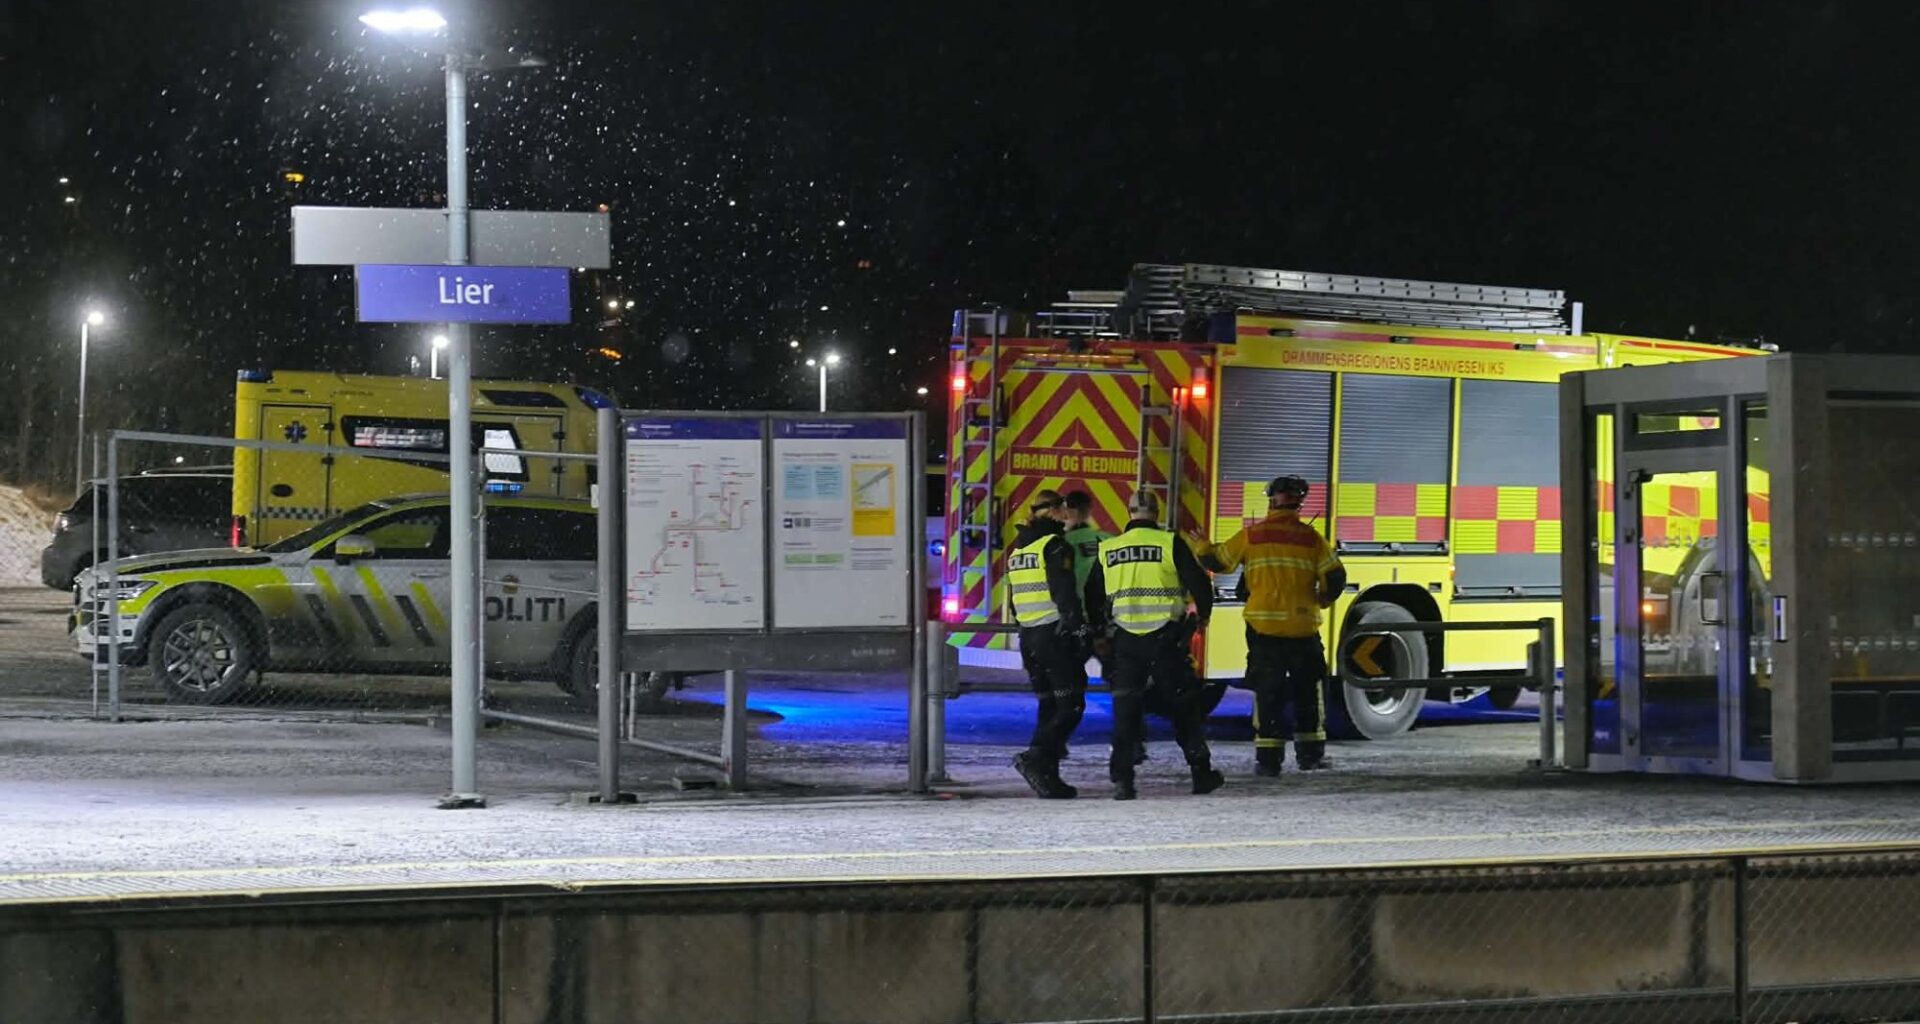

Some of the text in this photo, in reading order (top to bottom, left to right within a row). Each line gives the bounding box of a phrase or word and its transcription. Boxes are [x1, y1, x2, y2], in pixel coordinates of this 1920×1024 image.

[439, 277, 494, 304] Lier
[1282, 350, 1505, 375] DRAMMENSREGIONENS BRANNVESEN IKS
[1012, 453, 1138, 474] BRANN OG REDNING
[1008, 554, 1039, 570] OLITI
[1107, 546, 1161, 566] POLITI
[484, 597, 565, 621] OLITI
